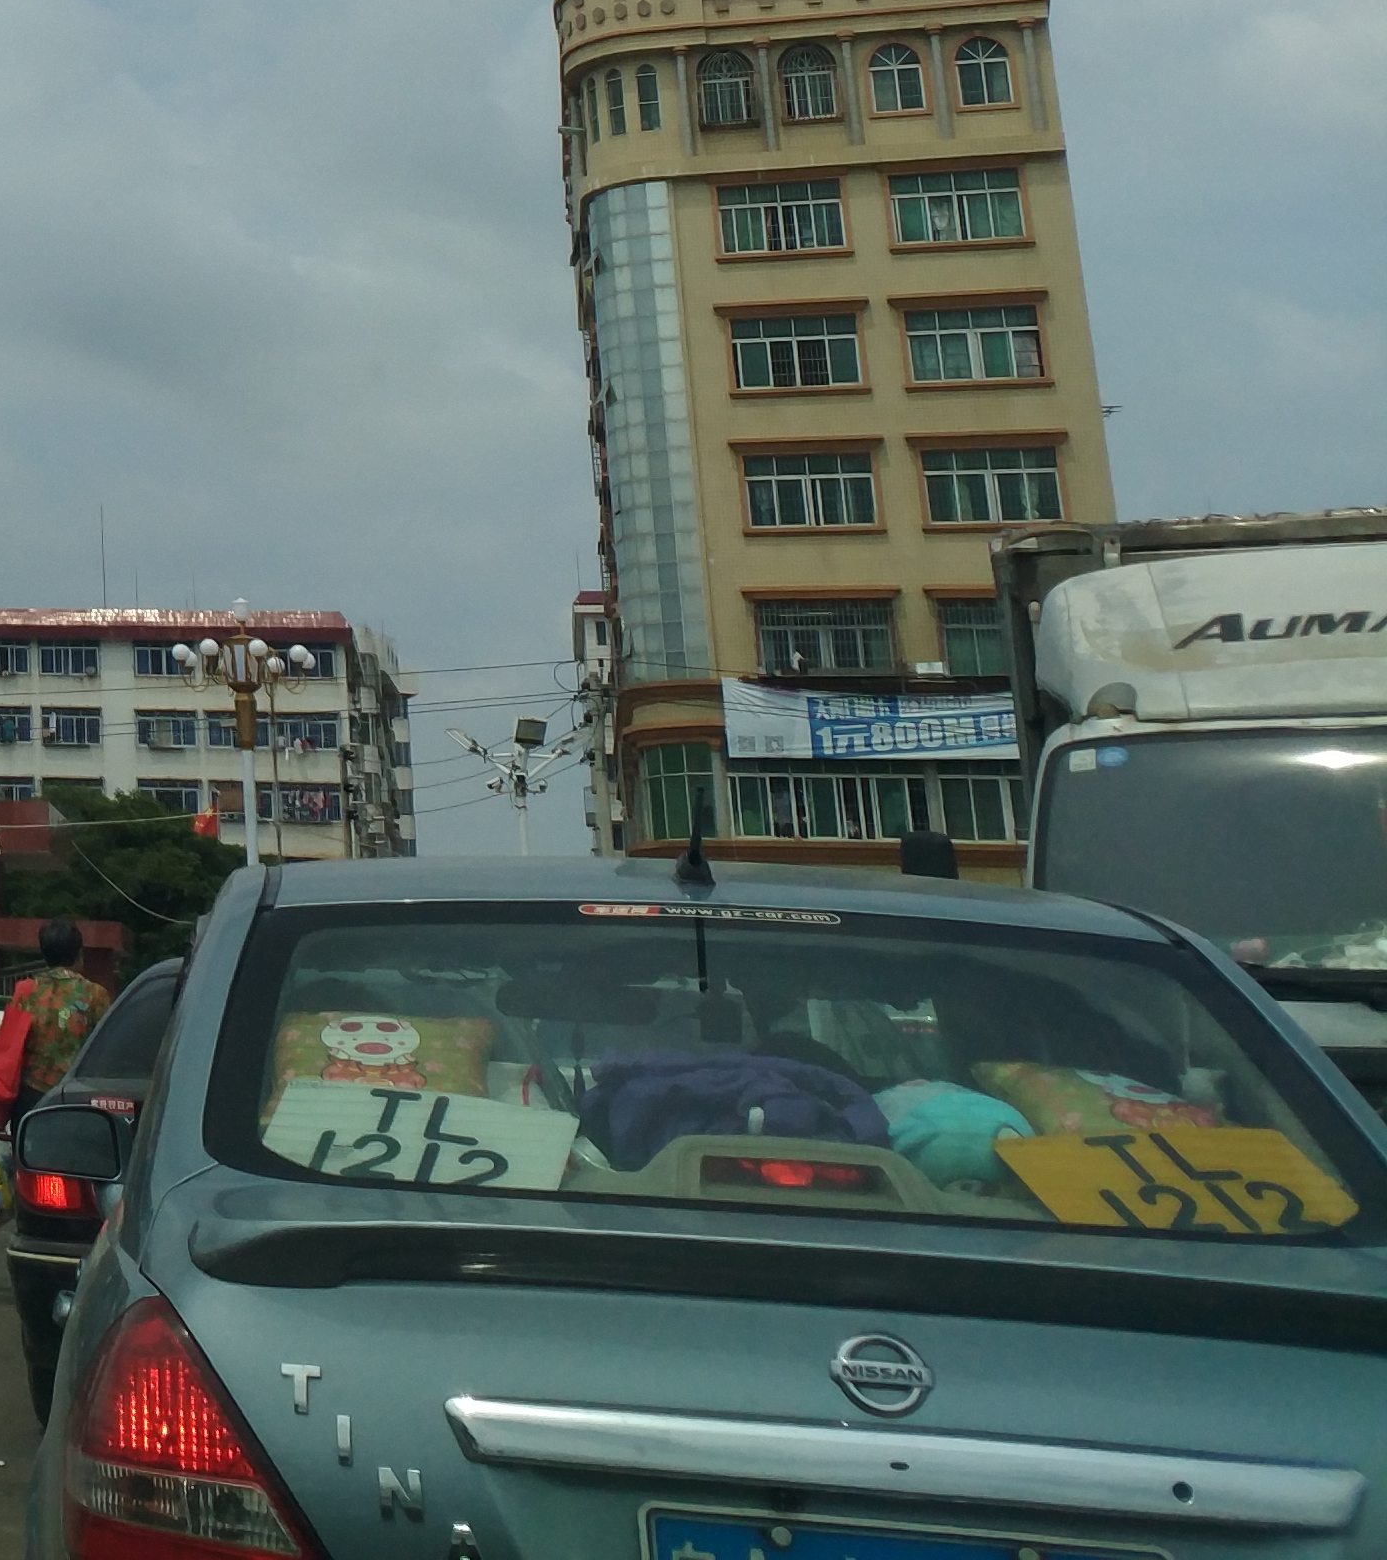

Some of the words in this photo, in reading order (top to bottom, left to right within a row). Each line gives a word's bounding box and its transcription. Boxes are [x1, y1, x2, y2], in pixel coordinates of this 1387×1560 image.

[1173, 611, 1387, 651] AUM
[370, 1088, 479, 1145] TL
[1084, 1132, 1243, 1183] TL
[842, 1365, 924, 1383] NISSAN
